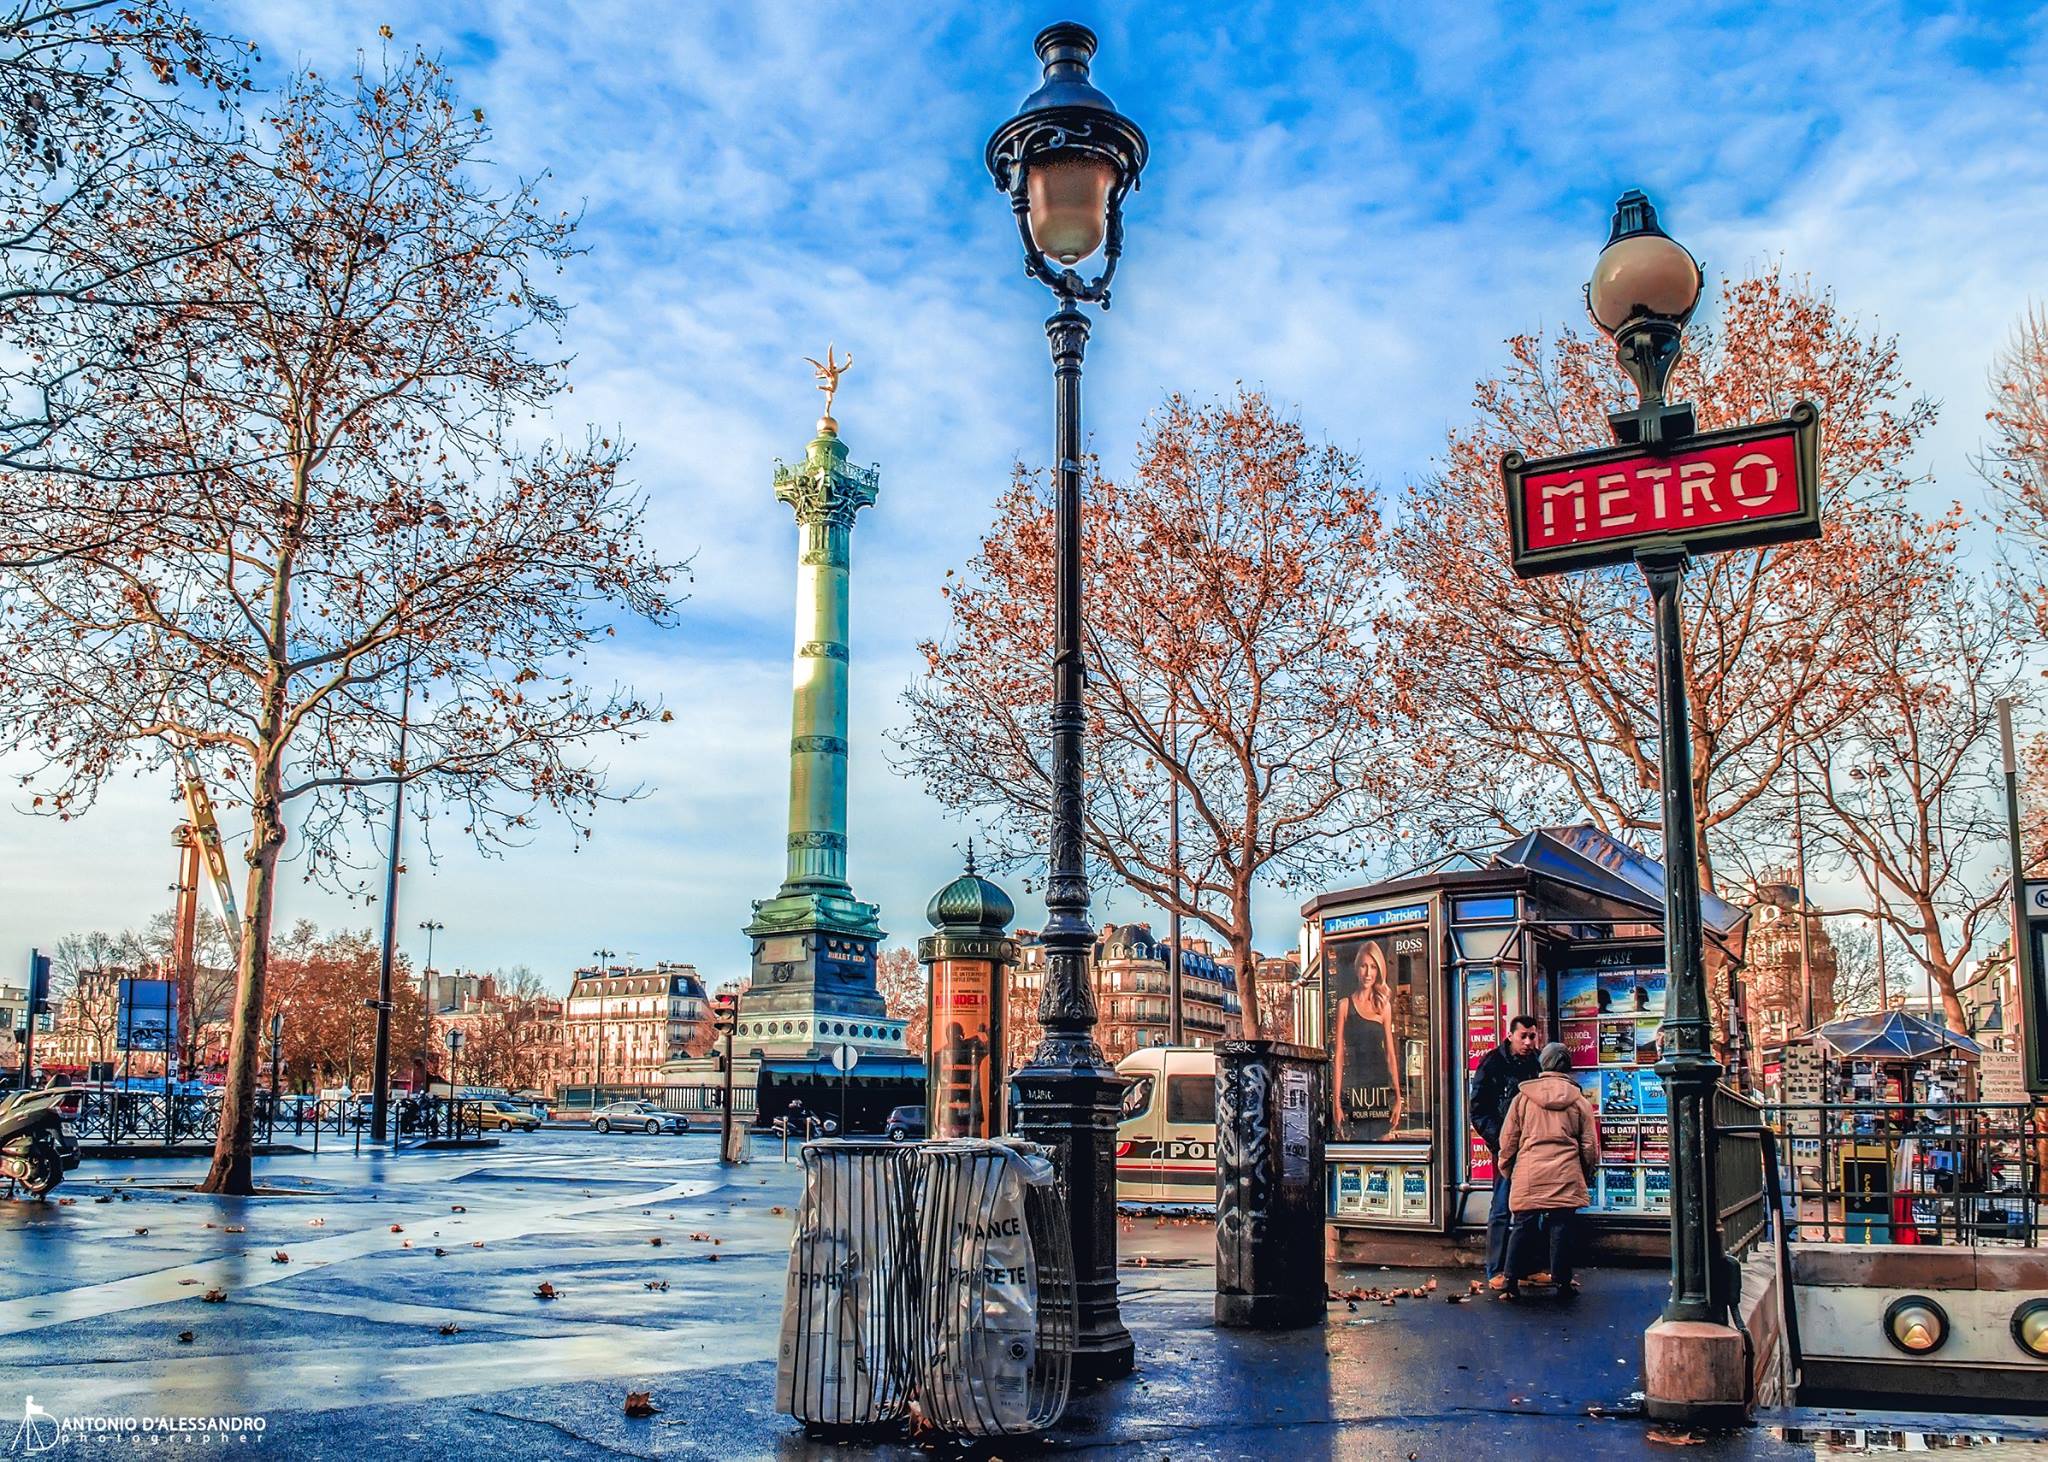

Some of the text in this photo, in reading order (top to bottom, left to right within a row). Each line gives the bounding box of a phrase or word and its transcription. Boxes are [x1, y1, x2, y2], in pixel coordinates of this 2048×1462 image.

[1386, 908, 1421, 924] Parisien
[1336, 916, 1368, 931] Parisien
[1395, 938, 1423, 951] BOSS
[1351, 1086, 1391, 1109] NUIT
[1353, 1110, 1390, 1119] POUR FEMME
[1602, 1126, 1637, 1134] BIG DATA
[1641, 1126, 1668, 1134] BIG DA
